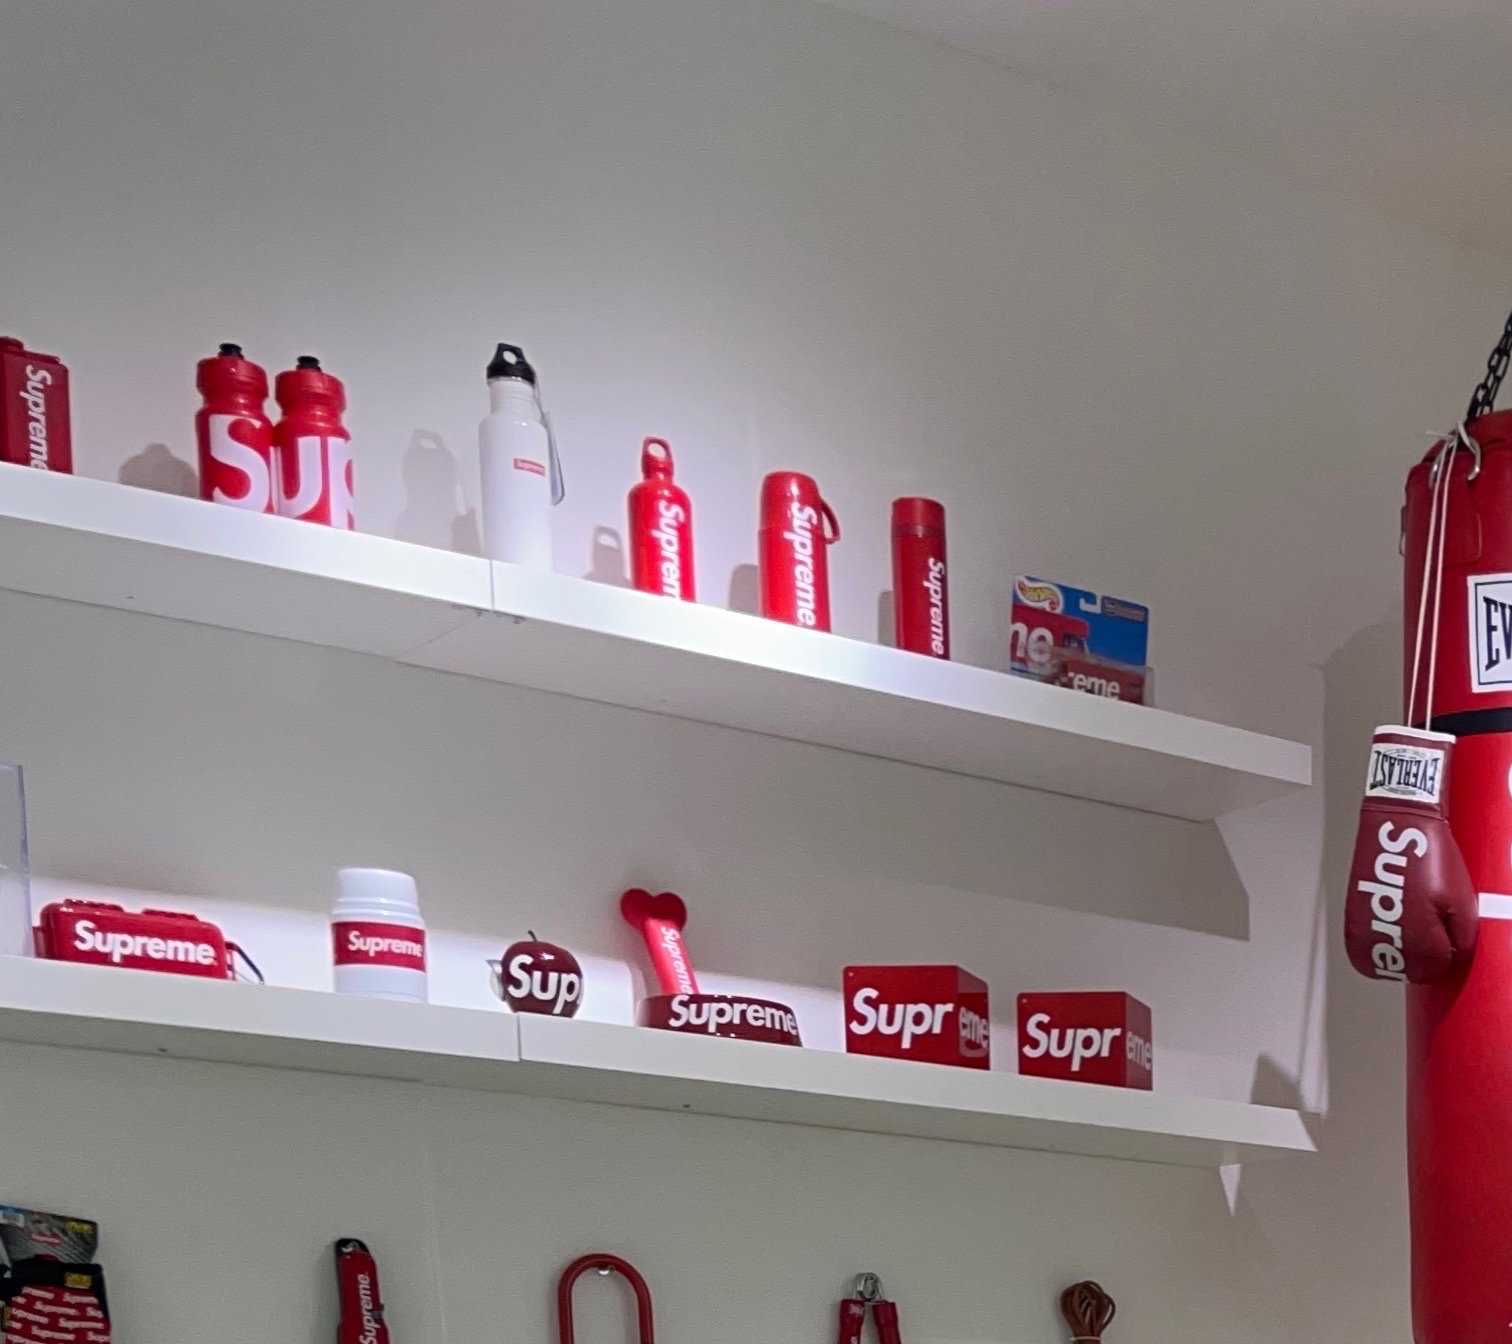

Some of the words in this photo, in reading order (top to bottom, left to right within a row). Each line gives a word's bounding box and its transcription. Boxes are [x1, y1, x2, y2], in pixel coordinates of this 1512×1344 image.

[783, 501, 817, 627] Supreme
[922, 557, 946, 656] Supreme
[1370, 750, 1440, 796] EVERLAST
[75, 921, 216, 962] Supreme
[348, 931, 422, 957] Supreme
[669, 994, 798, 1033] Supreme
